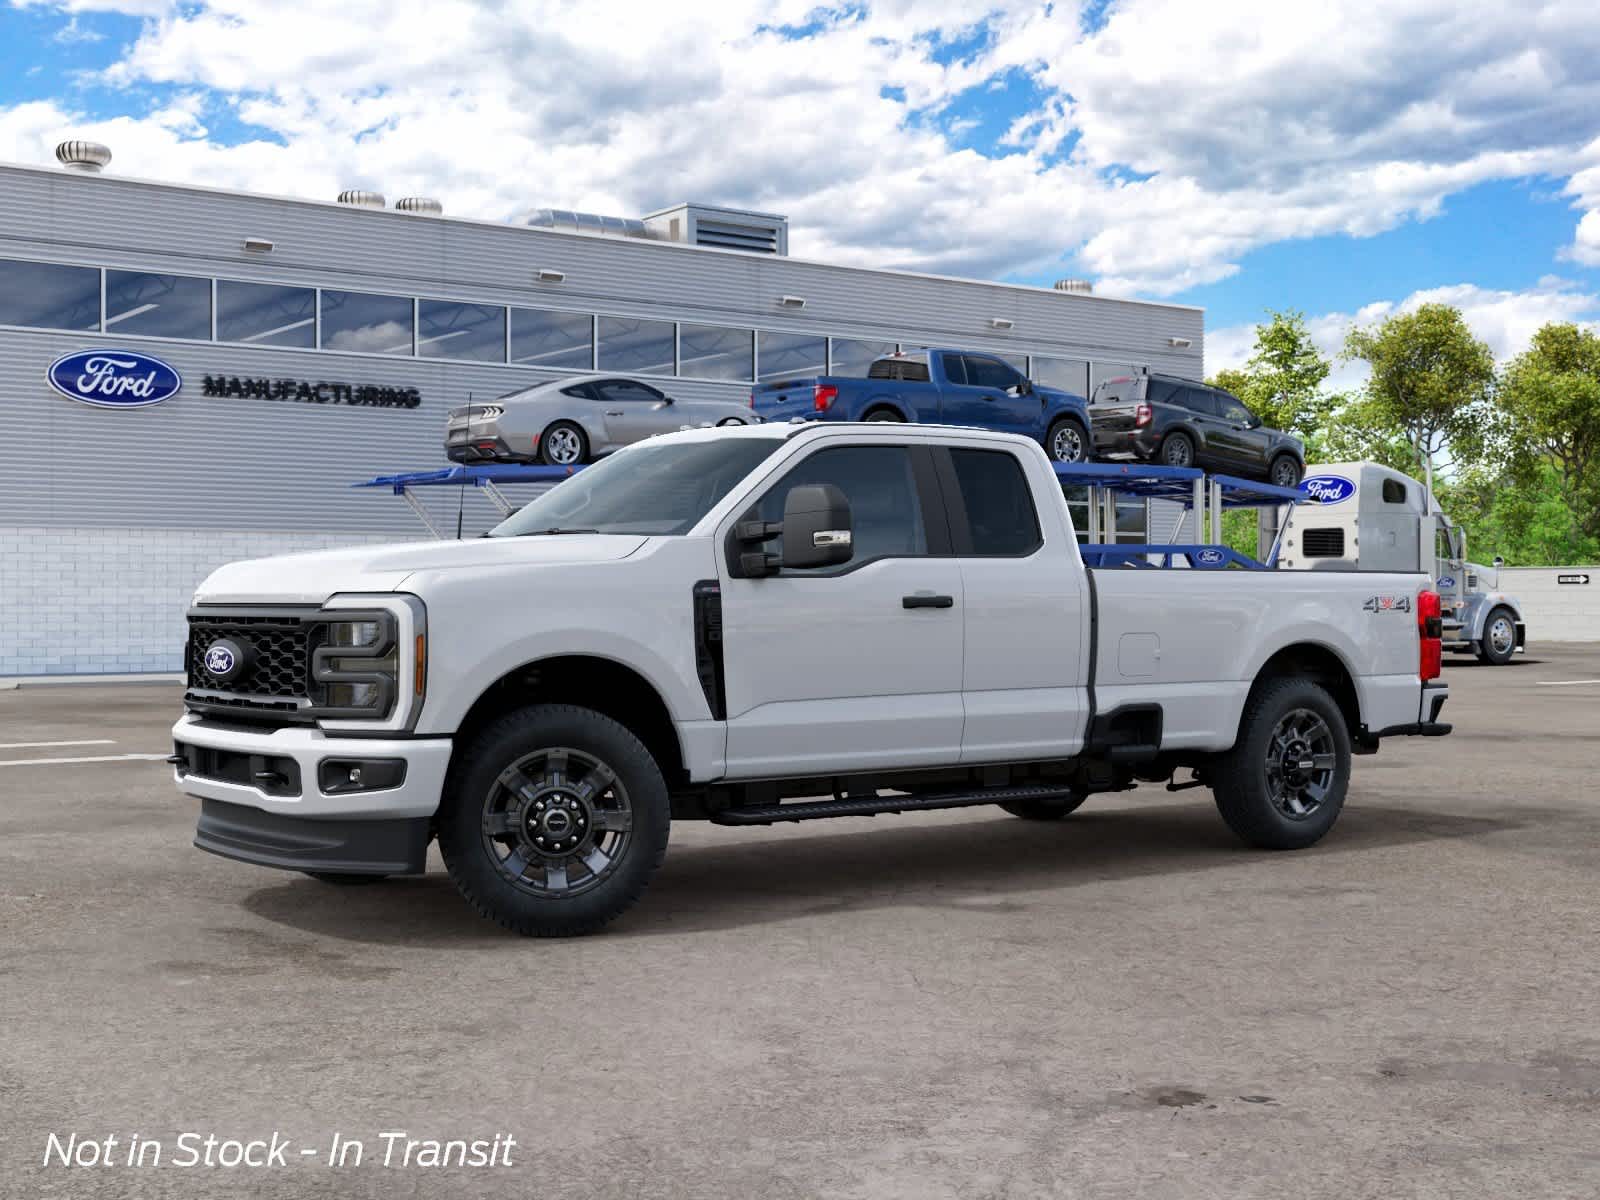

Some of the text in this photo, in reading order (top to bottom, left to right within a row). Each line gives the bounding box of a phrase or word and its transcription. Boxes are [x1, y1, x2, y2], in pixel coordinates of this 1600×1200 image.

[77, 357, 422, 409] Ford MANUFACTURING
[1307, 480, 1343, 500] Ford
[210, 650, 228, 670] Ford
